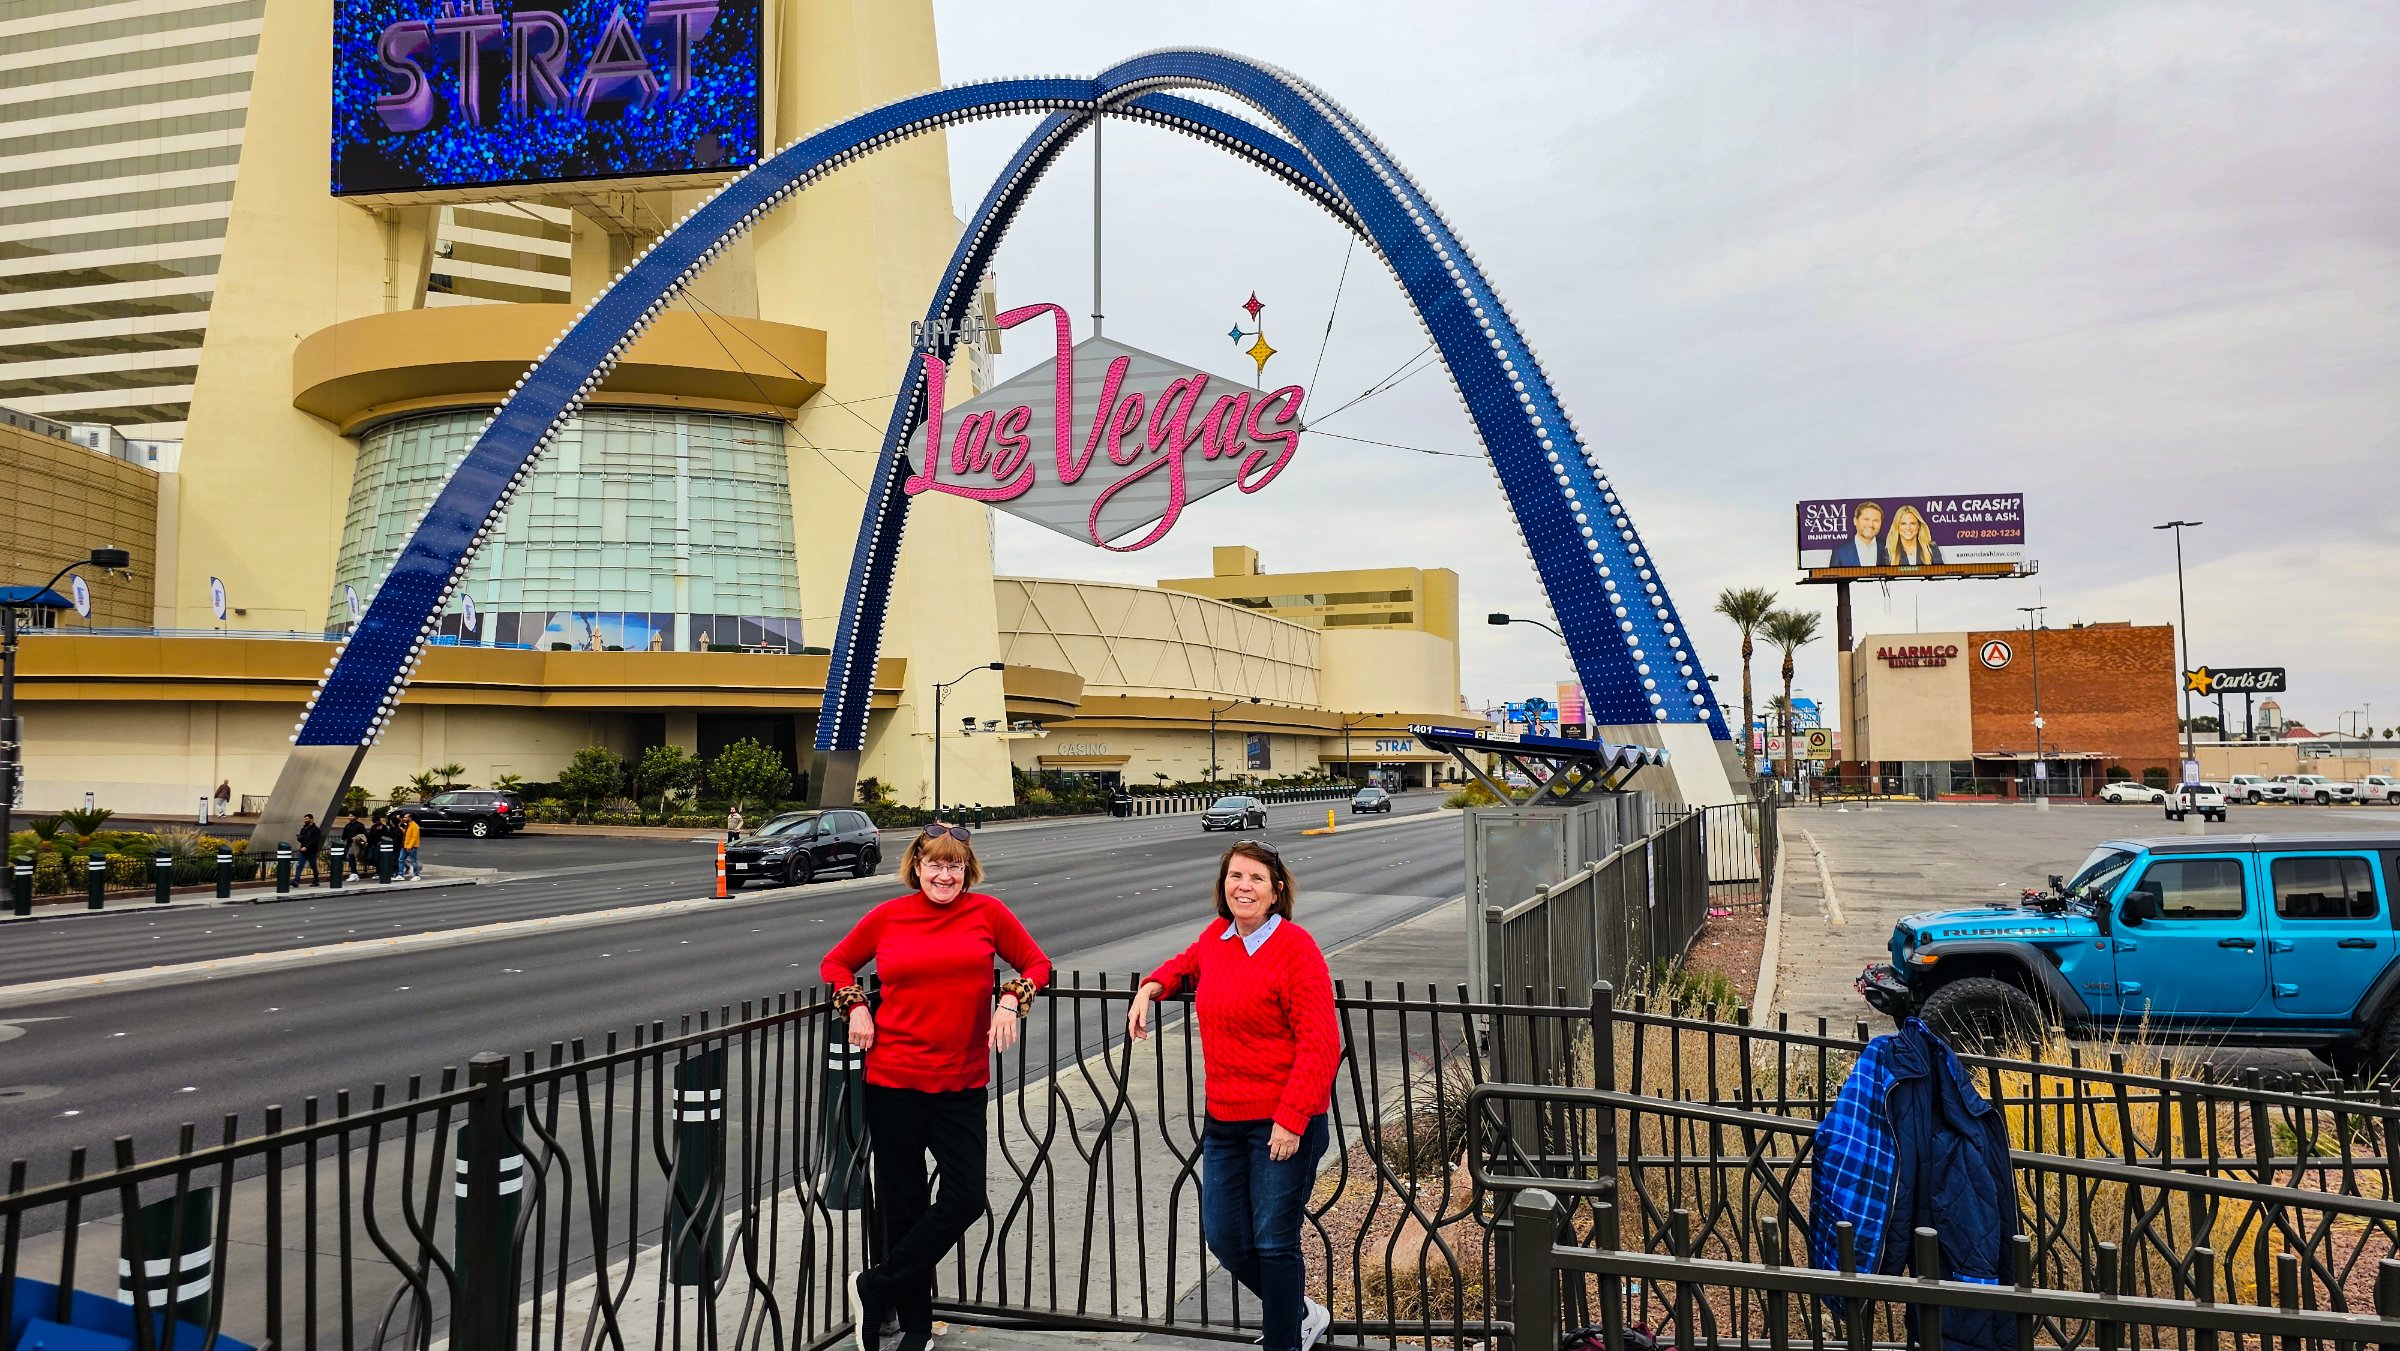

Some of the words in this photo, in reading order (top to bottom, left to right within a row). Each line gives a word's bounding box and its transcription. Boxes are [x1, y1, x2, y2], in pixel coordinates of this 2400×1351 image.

[376, 0, 719, 132] STRAT
[911, 317, 954, 347] CITY
[960, 315, 985, 344] OF
[904, 352, 1035, 502] Las
[995, 302, 1306, 553] Vegas
[1806, 503, 1848, 519] SAM
[1926, 500, 1943, 512] IN
[1946, 500, 1958, 512] A
[1961, 498, 2021, 511] CRASH?
[1931, 514, 1957, 524] CALL
[1958, 513, 1982, 523] SAM
[1984, 513, 1993, 522] &
[1995, 511, 2020, 521] ASH.
[1956, 530, 1979, 539] (702)
[1980, 528, 2021, 538] 820-1234
[1956, 550, 2021, 558] samandashlaw.com
[1877, 645, 1958, 659] ALARMCO
[1889, 659, 1920, 668] SINCE
[2211, 671, 2256, 690] Carl's
[2255, 671, 2280, 689] Jr.
[1408, 724, 1432, 735] 1401
[1058, 743, 1107, 756] CASINO
[1375, 739, 1414, 752] STRAT
[1943, 926, 2056, 937] RUBICON
